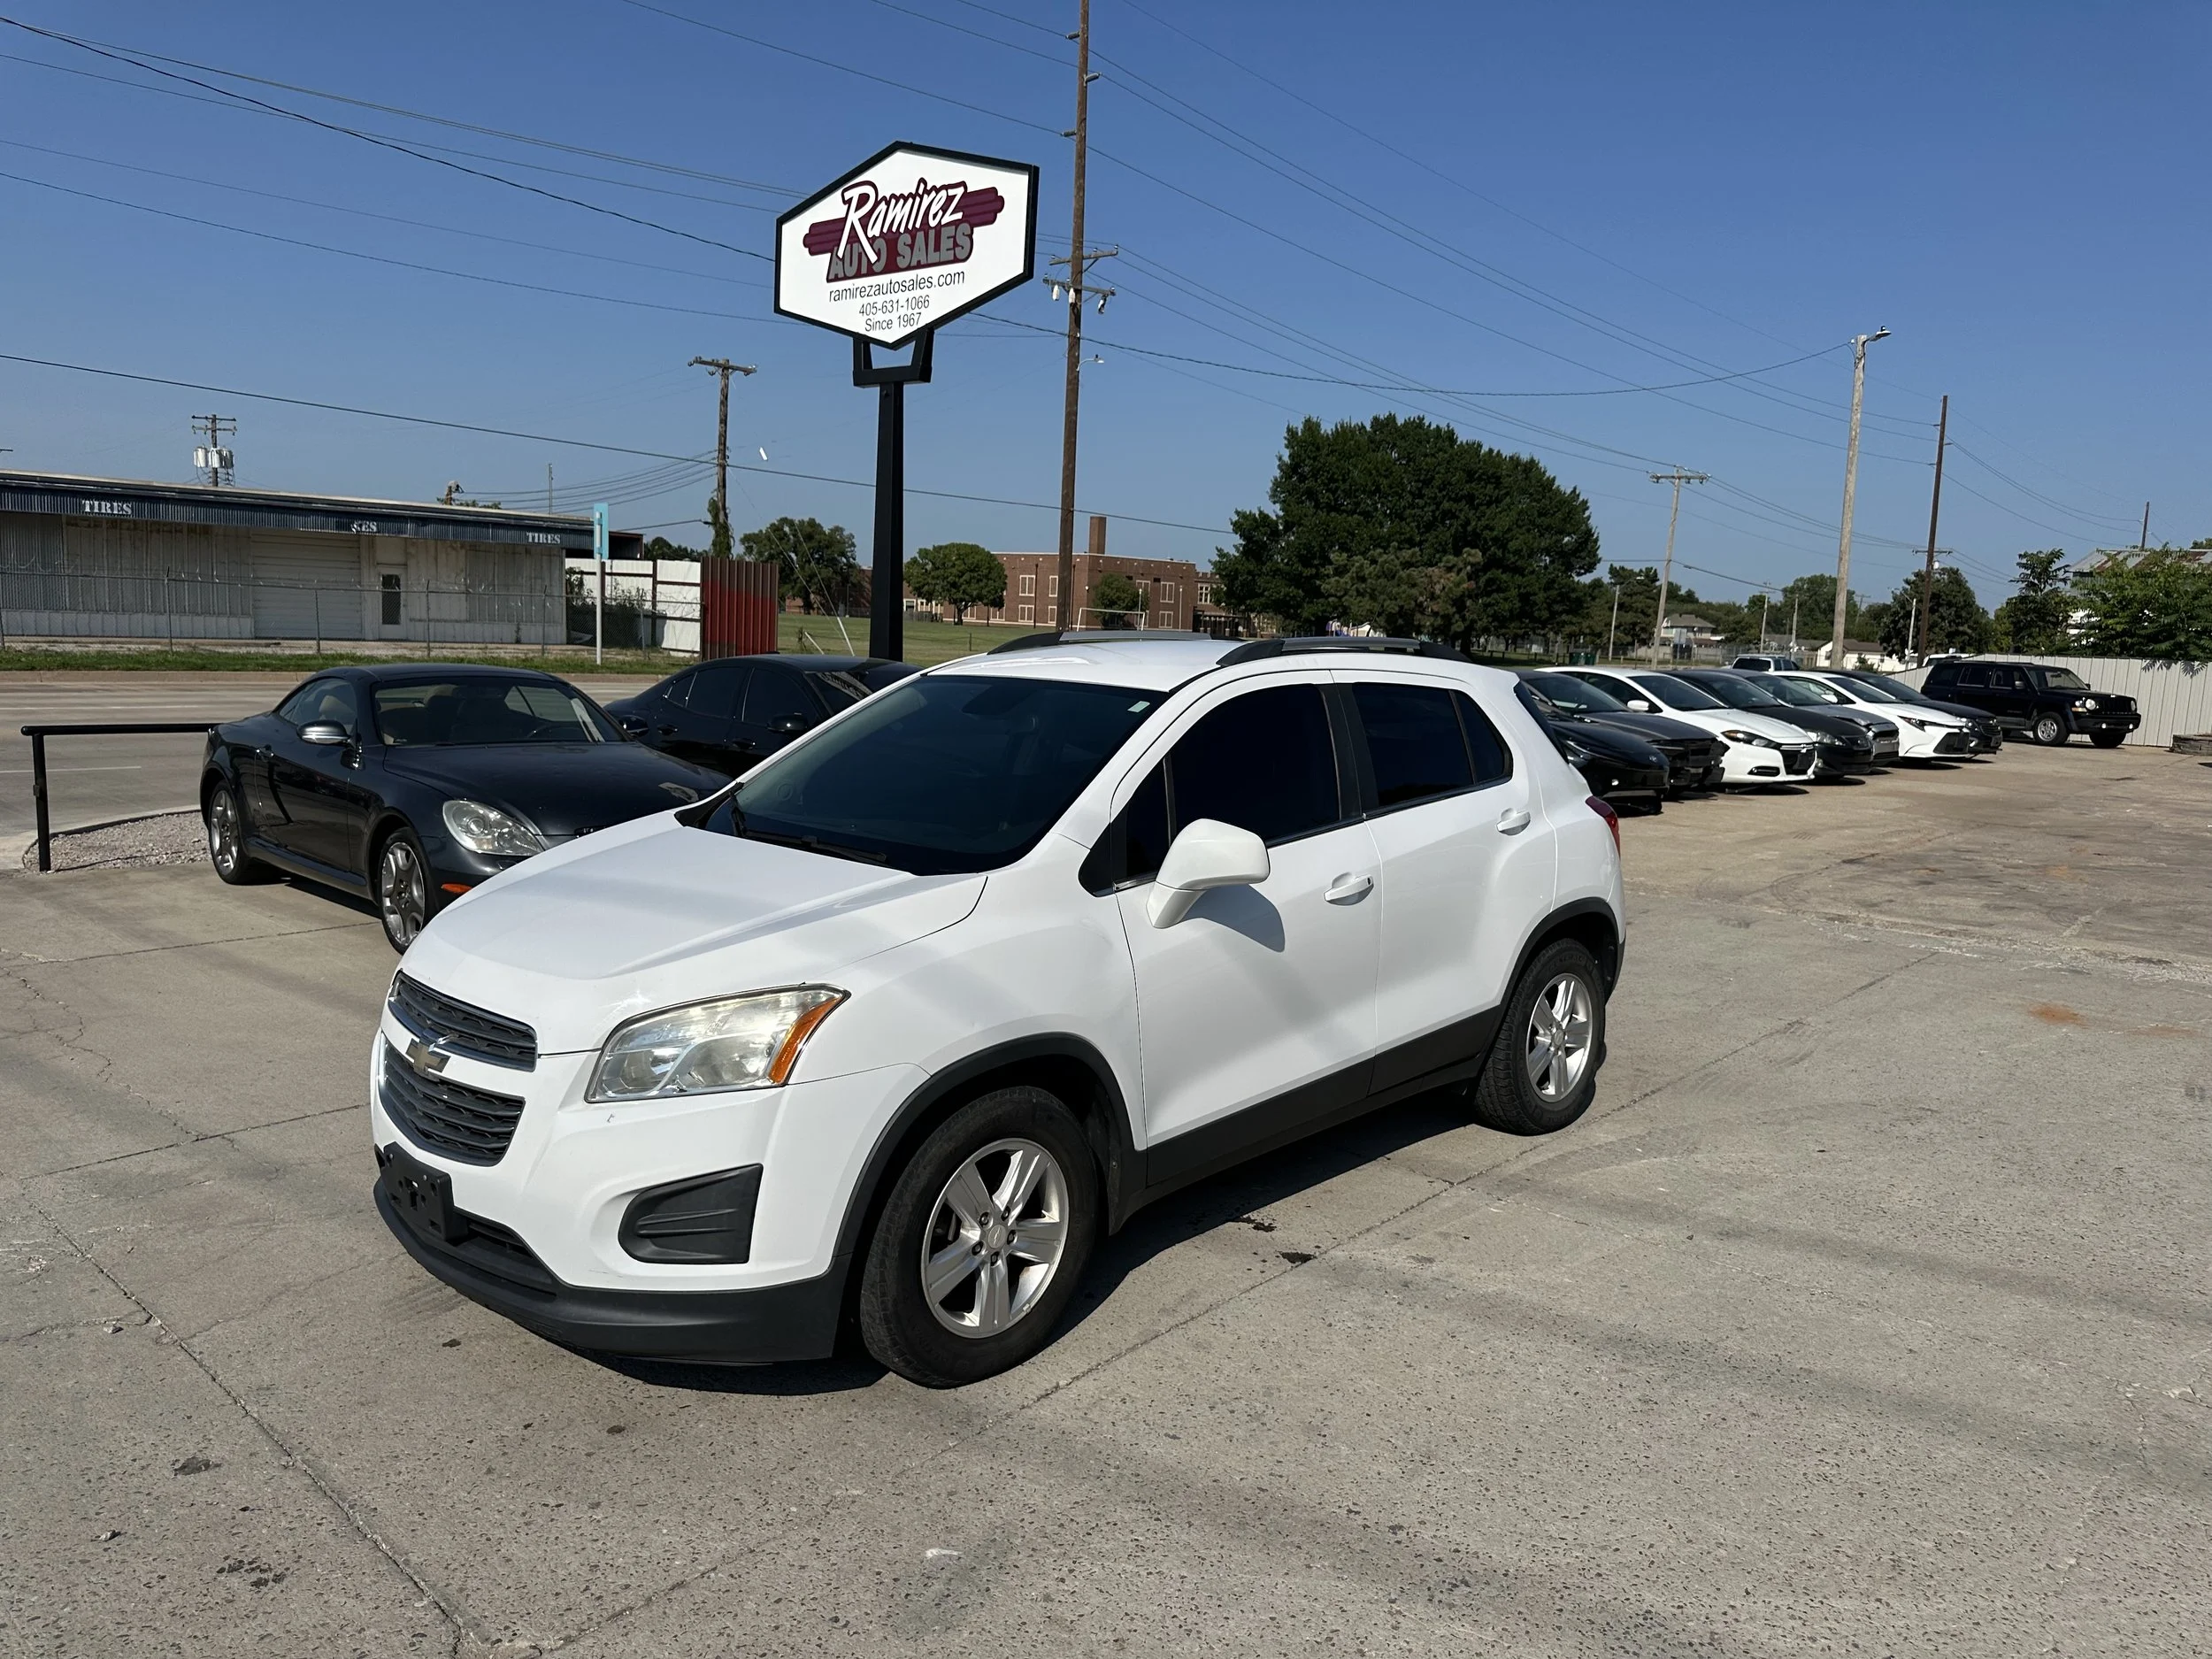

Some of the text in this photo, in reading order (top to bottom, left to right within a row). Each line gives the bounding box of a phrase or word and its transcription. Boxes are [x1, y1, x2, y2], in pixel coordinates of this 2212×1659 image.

[838, 178, 967, 265] Ramirez
[828, 222, 972, 280] AUTO SALES
[829, 271, 965, 303] ramirezautosales.com
[859, 295, 930, 317] 405-631-1066
[864, 312, 922, 332] Since 1967
[81, 500, 132, 515] TIRES
[526, 532, 561, 544] TIRES
